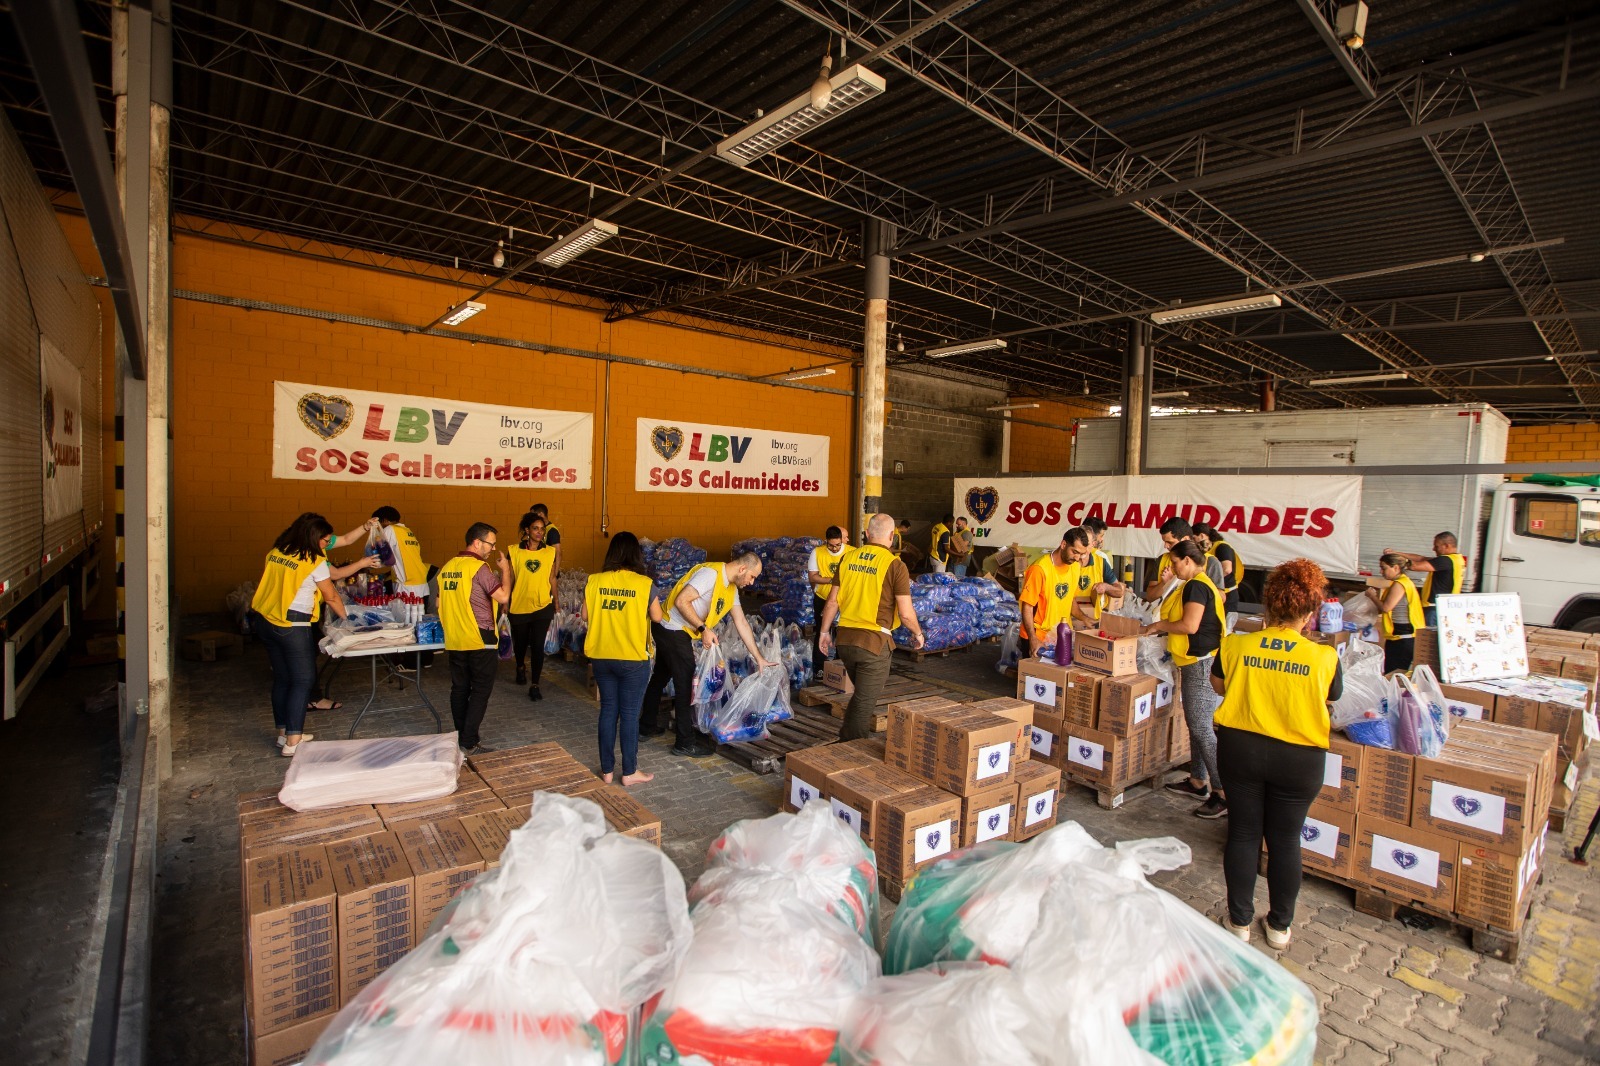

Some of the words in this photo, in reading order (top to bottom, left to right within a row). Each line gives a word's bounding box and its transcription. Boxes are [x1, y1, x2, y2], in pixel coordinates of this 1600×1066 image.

[362, 403, 469, 446] LBV
[500, 415, 543, 433] lbv.org
[499, 436, 564, 451] @LBVBrasil
[688, 432, 752, 464] LBV
[771, 439, 798, 453] lbv.org
[295, 447, 370, 475] SOS
[380, 452, 578, 484] Calamidades
[770, 455, 812, 466] @LBVBrasil
[649, 466, 693, 488] SOS
[699, 469, 820, 492] Calamidades
[1005, 500, 1063, 526] SOS
[1067, 502, 1337, 539] CALAMIDADES
[859, 551, 876, 561] LBV
[443, 580, 458, 591] LBV
[599, 587, 636, 598] VOLUNTÁRIO
[601, 598, 627, 611] LBV
[1260, 636, 1298, 652] LBV
[1243, 655, 1311, 676] VOLUNTÁRIO
